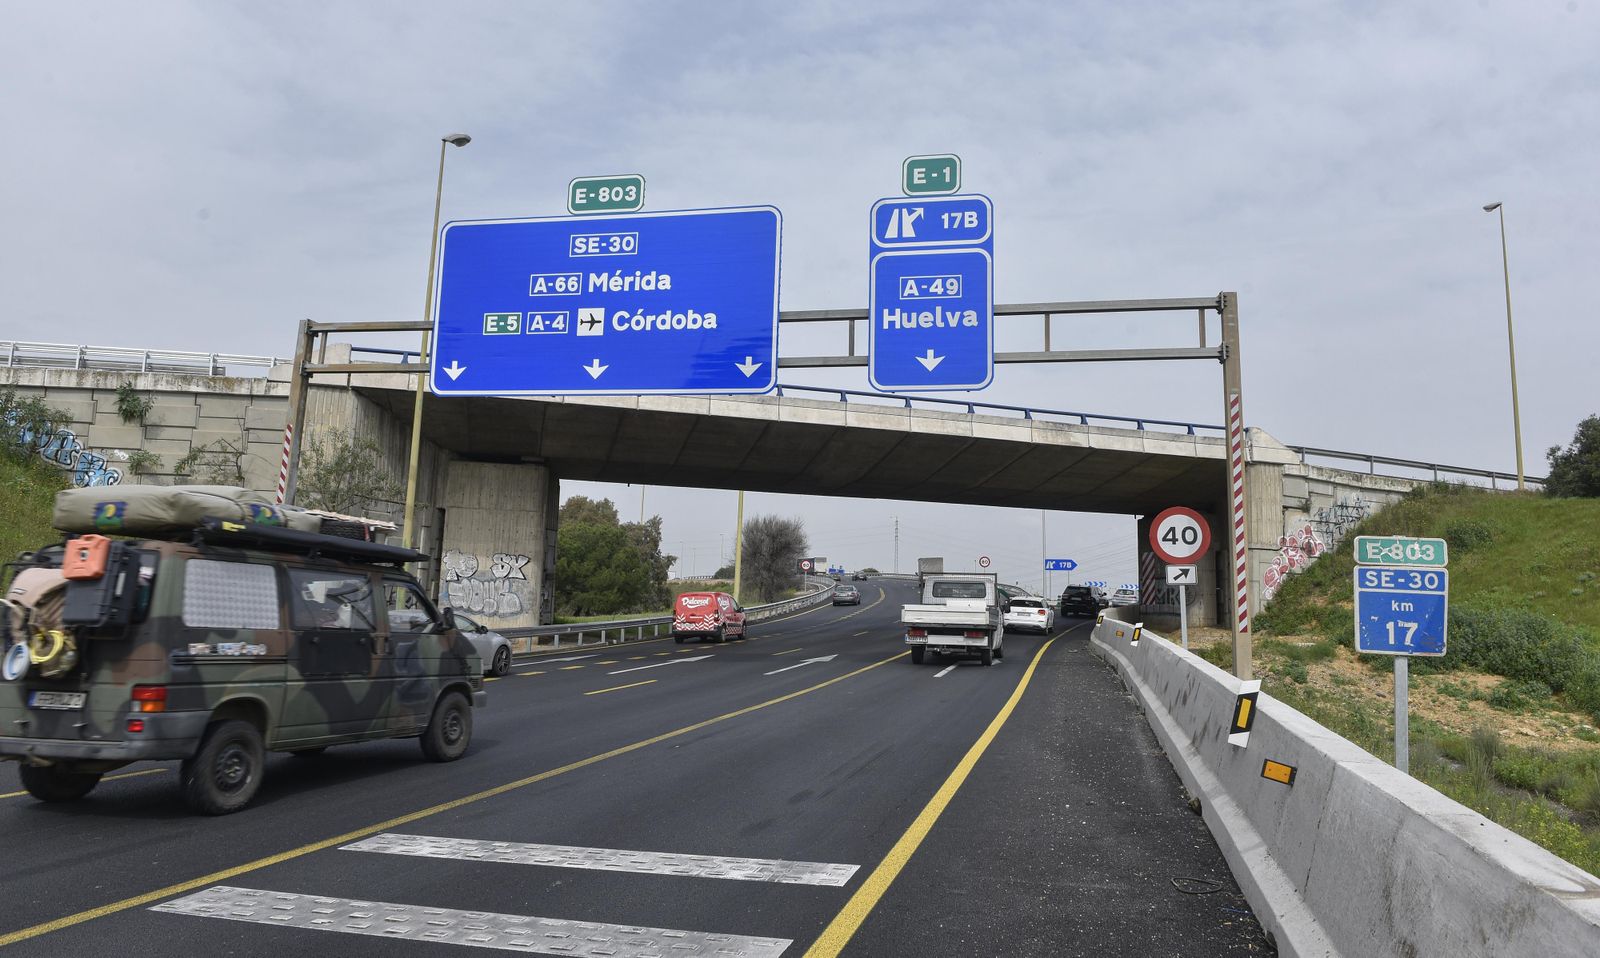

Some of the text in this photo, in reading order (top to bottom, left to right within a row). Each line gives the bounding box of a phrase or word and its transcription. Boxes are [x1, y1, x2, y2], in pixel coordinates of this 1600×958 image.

[575, 184, 637, 204] E-803
[941, 210, 979, 229] 17B
[573, 234, 635, 254] SE-30
[533, 270, 672, 294] A-66 Mérida
[902, 278, 959, 297] A-49
[485, 308, 718, 333] E-5 A-4 Córdoba
[882, 305, 979, 329] Huelva
[1161, 526, 1198, 546] 40
[1366, 542, 1435, 562] E-803
[1059, 561, 1072, 569] 17B
[1365, 570, 1440, 590] SE-30
[1391, 599, 1414, 612] km
[1385, 620, 1419, 646] 17
